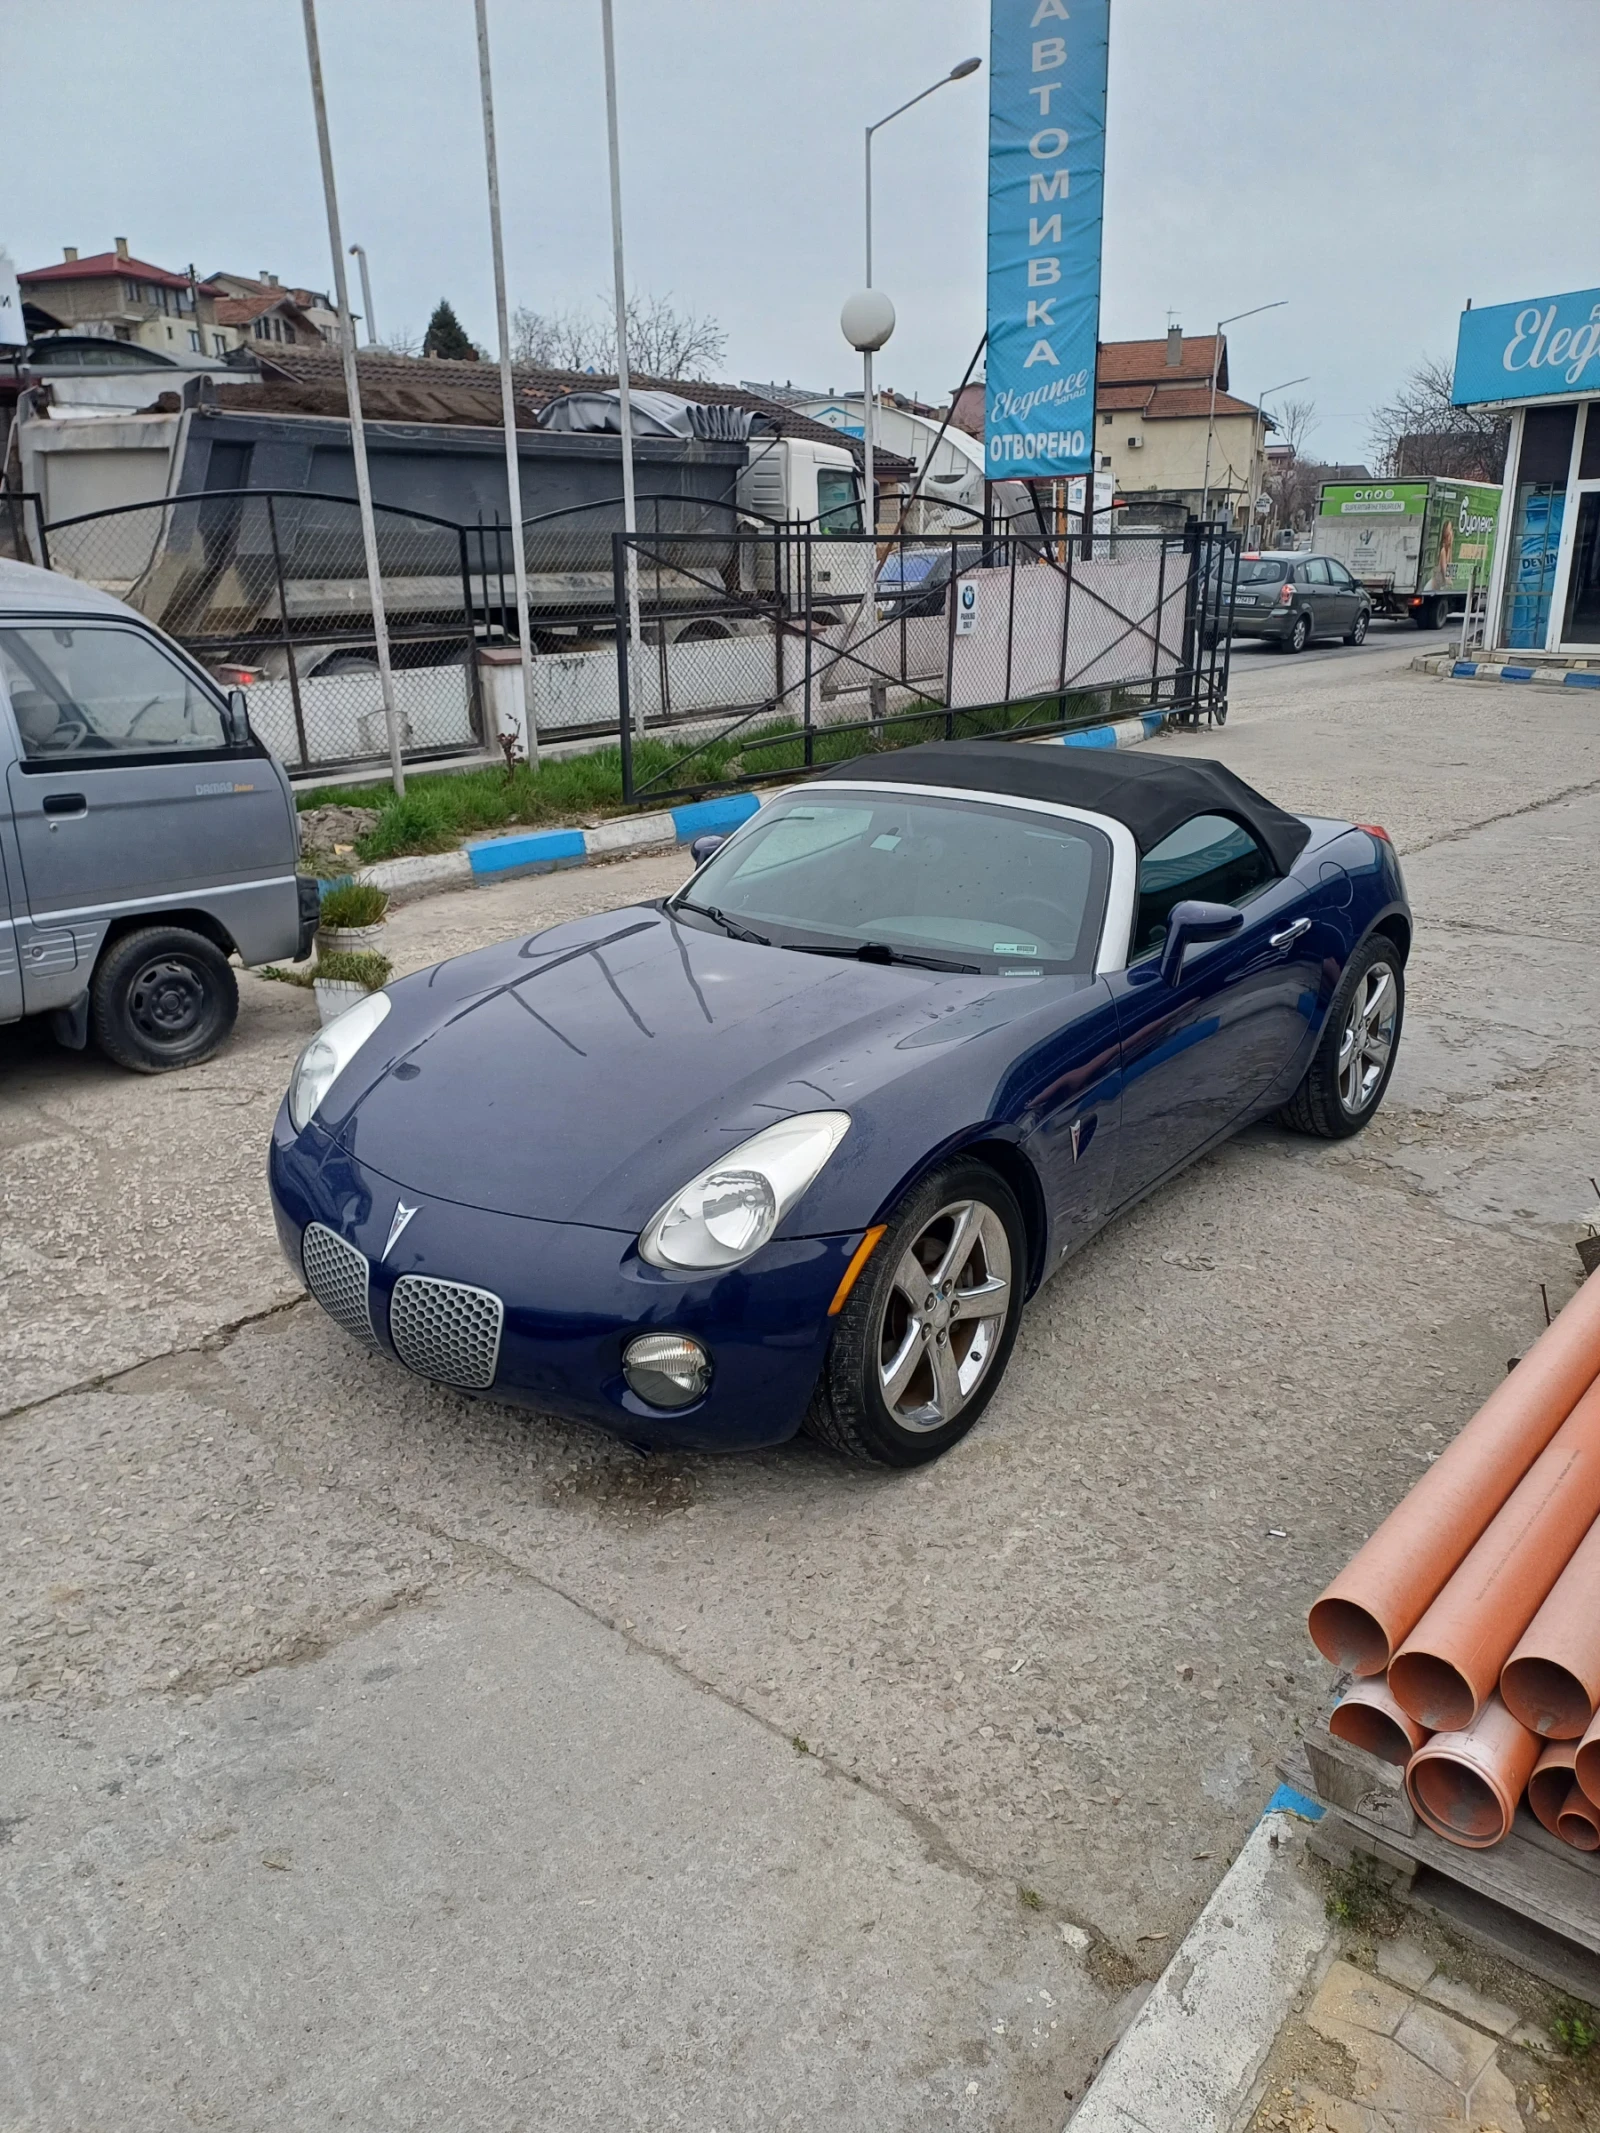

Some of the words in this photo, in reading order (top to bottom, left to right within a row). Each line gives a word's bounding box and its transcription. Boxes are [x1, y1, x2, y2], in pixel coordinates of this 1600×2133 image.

[1023, 0, 1070, 367] АВТОМИВКА
[1503, 305, 1600, 384] Eleg
[991, 369, 1089, 423] Elegance
[990, 430, 1085, 462] ОТВОРЕНО
[196, 782, 233, 796] DAMAS
